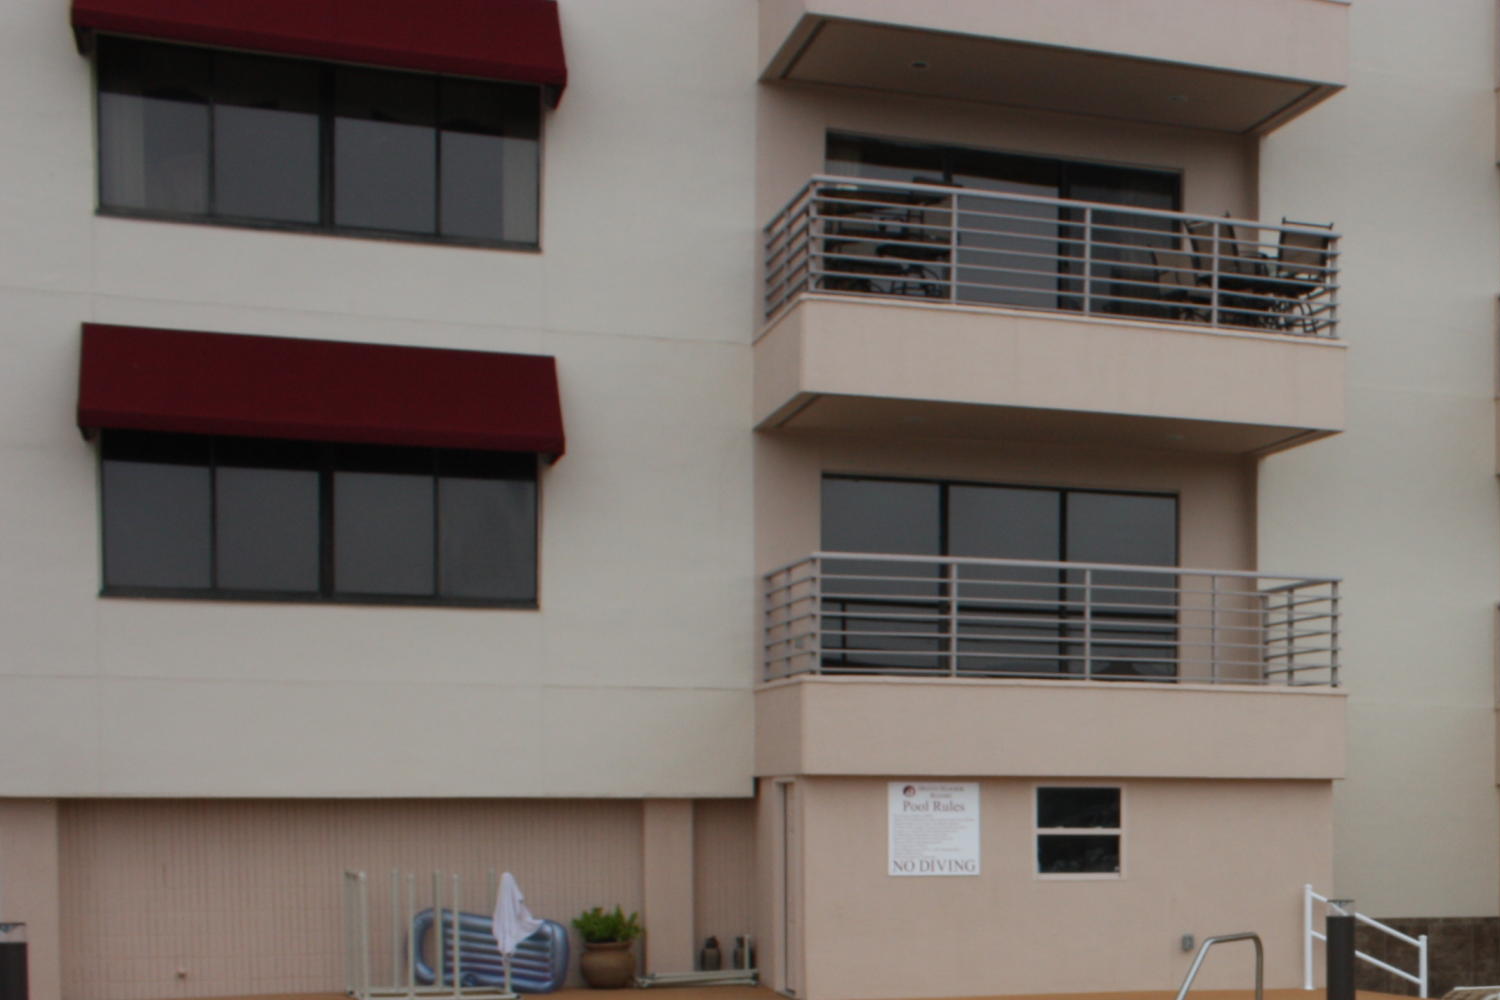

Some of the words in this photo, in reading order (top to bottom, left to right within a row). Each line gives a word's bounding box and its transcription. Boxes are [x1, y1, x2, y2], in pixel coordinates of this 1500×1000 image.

[903, 800, 929, 812] Pool
[933, 800, 965, 812] Rules
[892, 860, 915, 873] NO
[919, 859, 976, 873] DIVING
